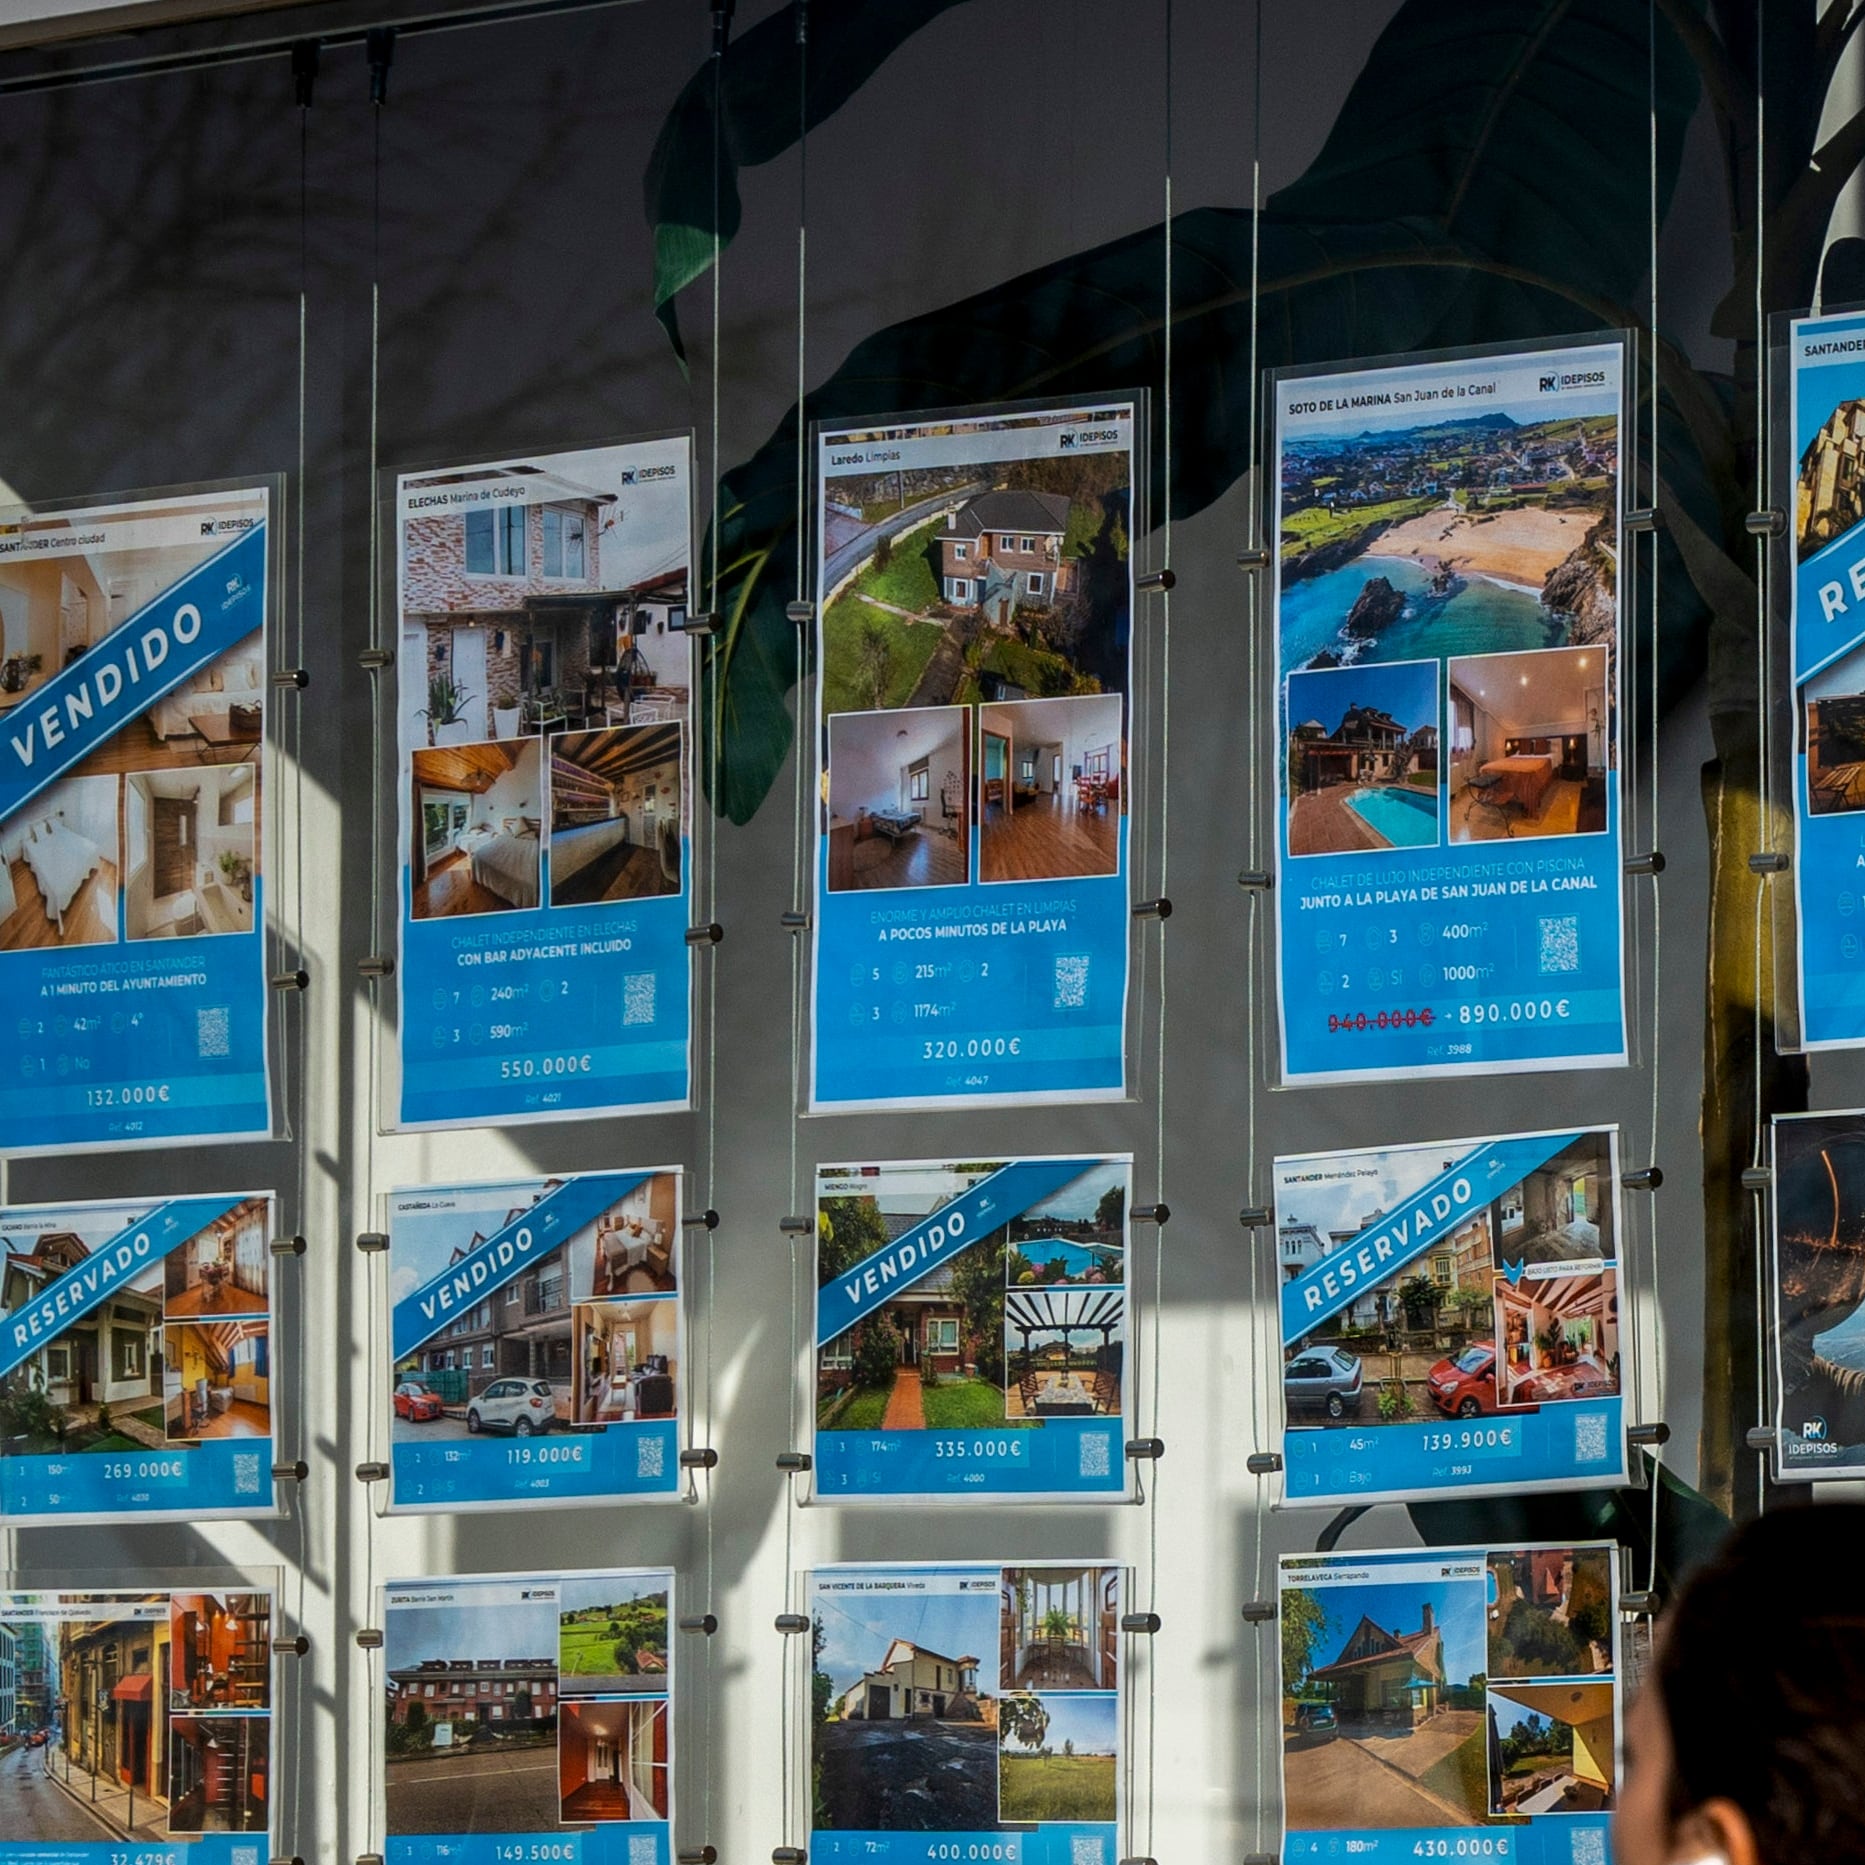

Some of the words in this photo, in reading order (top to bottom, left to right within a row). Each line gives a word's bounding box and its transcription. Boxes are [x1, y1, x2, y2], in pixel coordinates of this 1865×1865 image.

[1539, 375, 1556, 393] RK
[1561, 371, 1605, 386] IDEPISOS
[1289, 402, 1316, 416] SOTO
[1320, 400, 1333, 412] DE
[1336, 398, 1349, 410] LA
[1351, 394, 1392, 409] MARINA
[1393, 391, 1413, 404] San
[1414, 388, 1439, 402] Juan
[1441, 386, 1454, 399] de
[1457, 384, 1466, 396] la
[1468, 382, 1497, 396] Canal
[1059, 432, 1075, 449] RK
[1080, 429, 1118, 443] IDEPISOS
[831, 452, 864, 466] Laredo
[865, 449, 901, 465] Limpias
[621, 470, 635, 486] RK
[639, 465, 675, 479] IDEPISOS
[408, 494, 448, 509] ELECHAS
[450, 491, 479, 505] Marina
[480, 490, 491, 501] de
[492, 484, 526, 499] Cudeyo
[201, 519, 216, 536] RK
[10, 603, 202, 768] VENDIDO
[1856, 854, 1865, 867] A
[1300, 894, 1341, 910] JUNTO
[1344, 893, 1354, 907] A
[1356, 892, 1373, 907] LA
[1375, 888, 1418, 904] PLAYA
[1421, 887, 1438, 901] DE
[1442, 885, 1468, 900] SAN
[1471, 883, 1506, 898] JUAN
[1510, 880, 1528, 895] DE
[1531, 880, 1549, 894] LA
[1552, 875, 1598, 892] CANAL
[457, 953, 481, 967] CON
[484, 949, 507, 964] BAR
[510, 944, 578, 962] ADYACENTE
[580, 938, 632, 957] INCLUIDO
[1459, 998, 1570, 1024] 890.000€
[923, 1037, 1022, 1059] 320.000€
[501, 1054, 592, 1078] 550.000€
[88, 1085, 171, 1107] 132.000€
[1302, 1177, 1473, 1313] RESERVADO
[844, 1211, 966, 1305] VENDIDO
[420, 1227, 533, 1321] VENDIDO
[13, 1231, 151, 1349] RESERVADO
[1422, 1428, 1512, 1452] 139.900€
[1803, 1422, 1822, 1440] RK
[507, 1446, 583, 1466] 119.000€
[935, 1439, 1022, 1458] 335.000€
[1788, 1442, 1838, 1456] IDEPISOS
[104, 1461, 183, 1479] 269.000€
[496, 1843, 575, 1861] 149.500€
[927, 1843, 1017, 1861] 400.000€
[1413, 1838, 1508, 1857] 430.000€
